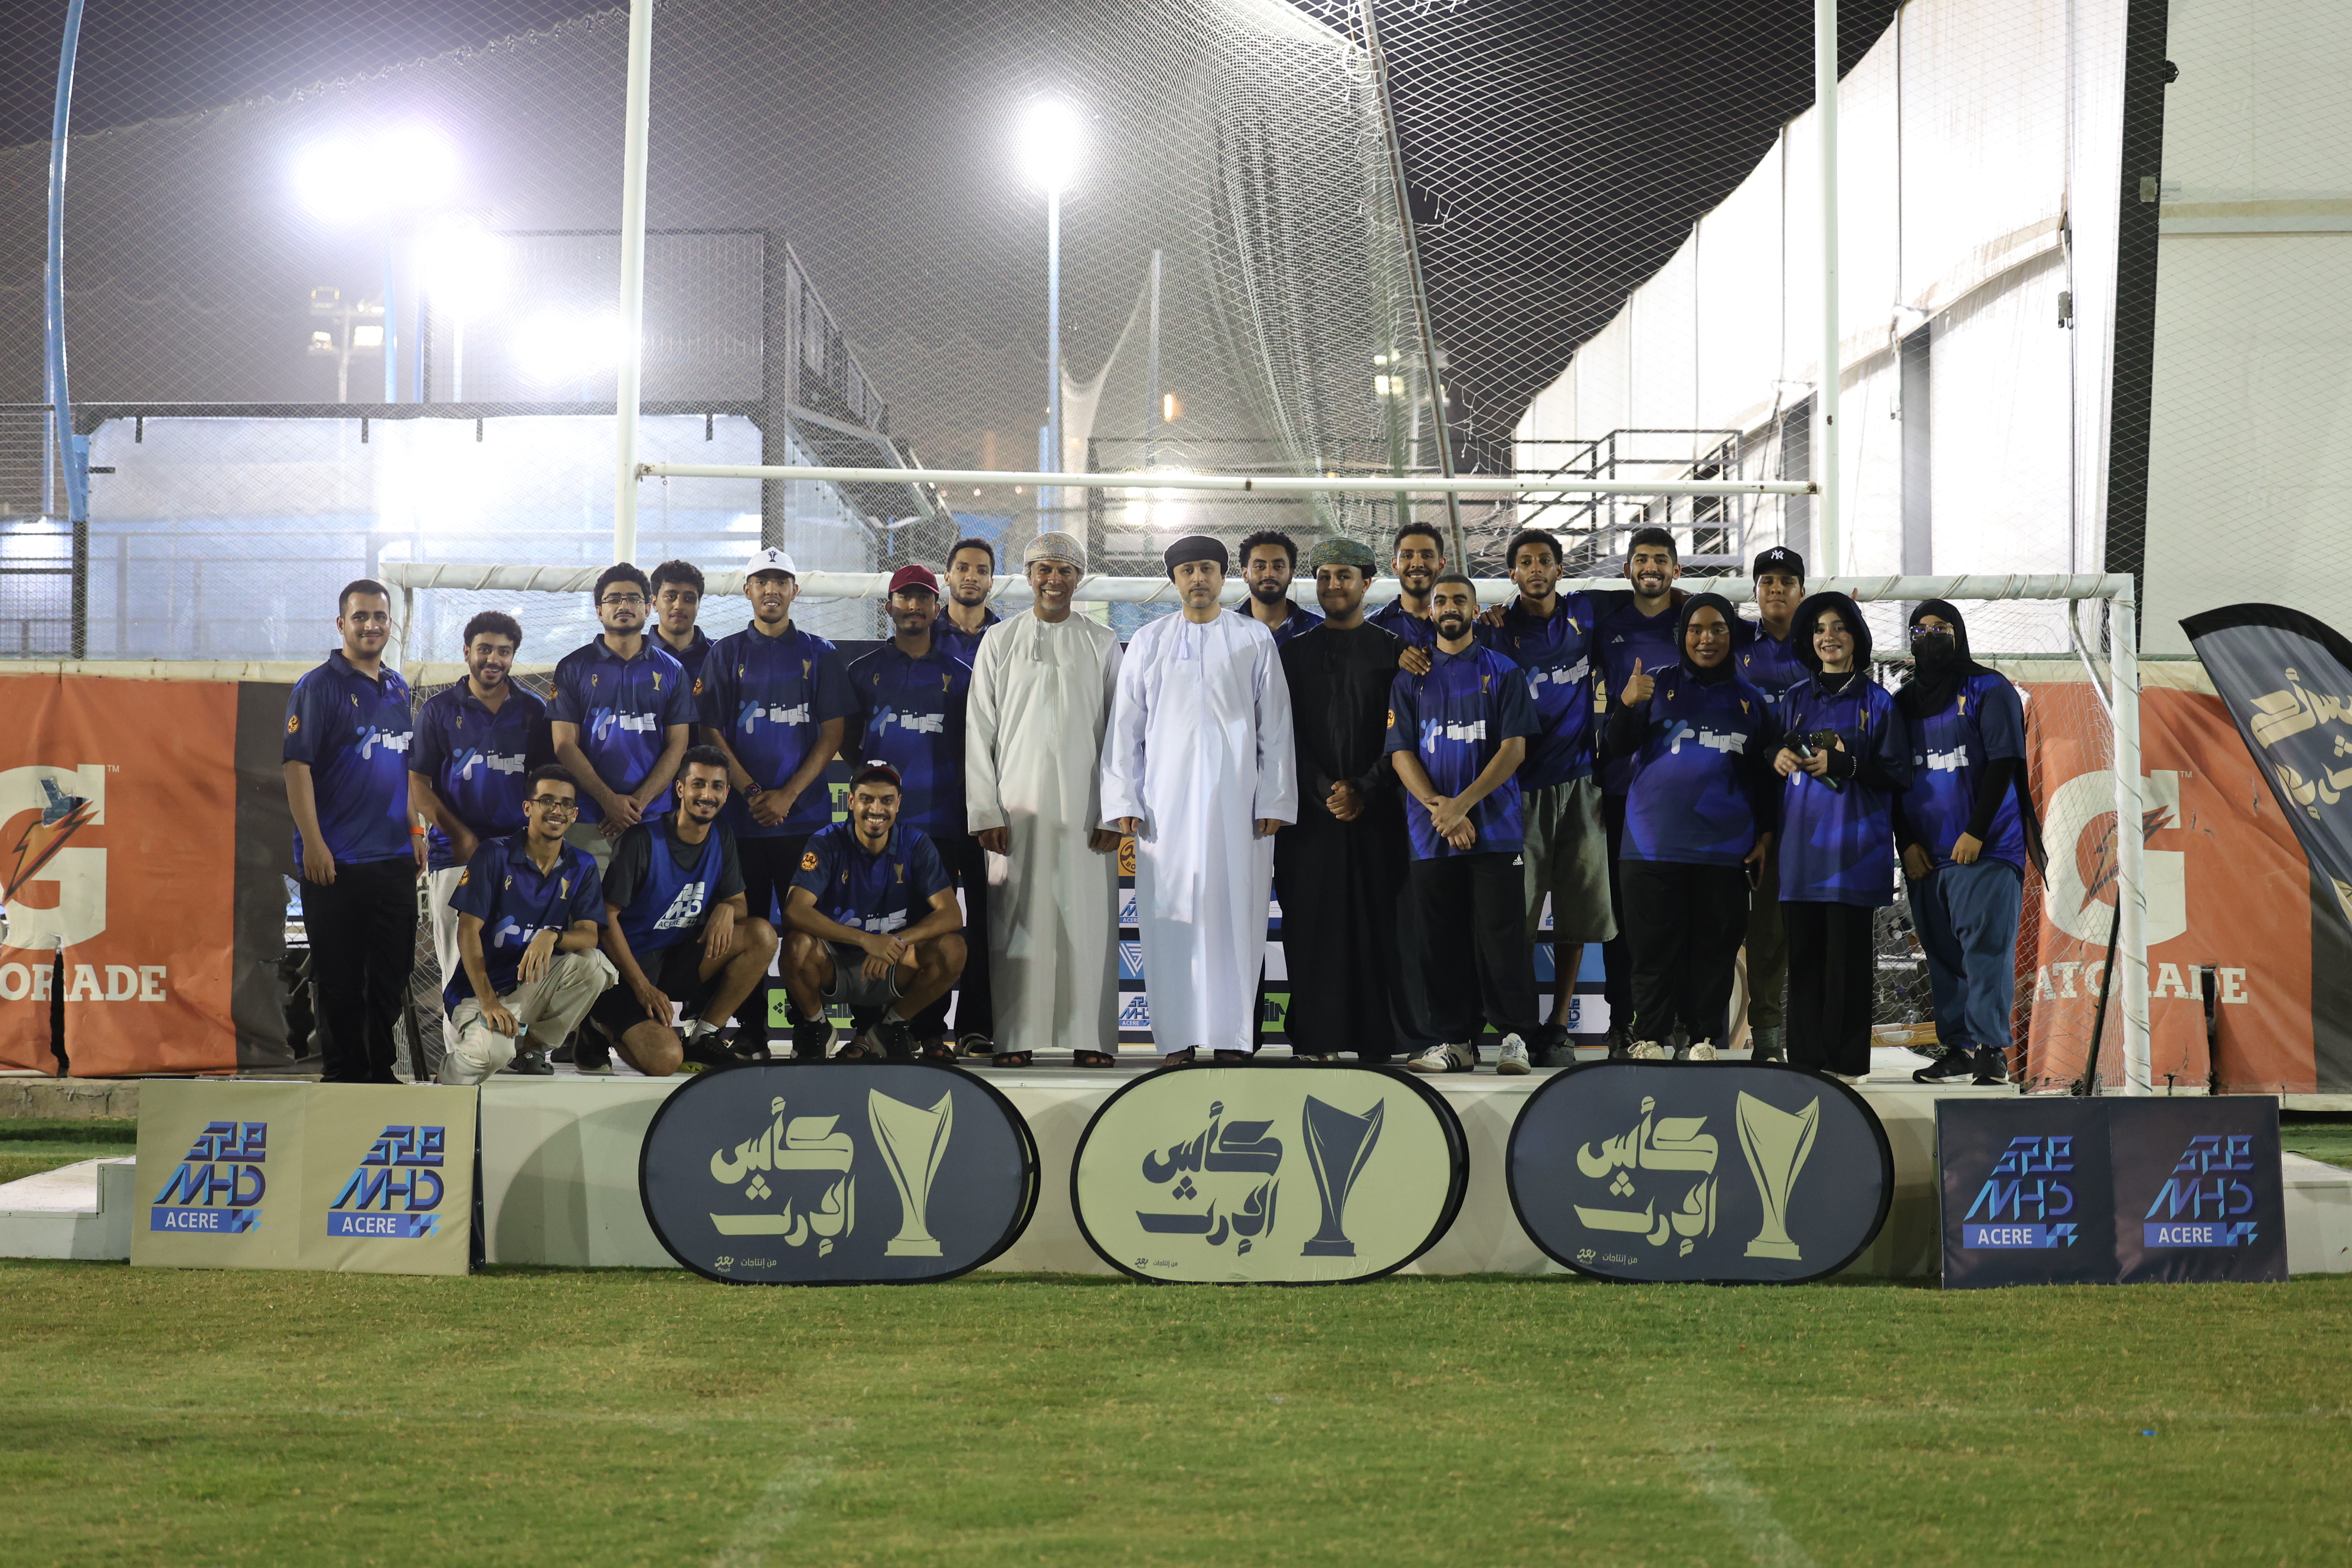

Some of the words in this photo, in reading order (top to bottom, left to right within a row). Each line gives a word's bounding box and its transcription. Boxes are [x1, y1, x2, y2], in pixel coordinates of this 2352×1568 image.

[0, 764, 107, 950] G
[107, 765, 120, 773] TM
[2043, 770, 2186, 947] G
[659, 900, 702, 920] MHD
[658, 919, 680, 928] ACERE
[710, 1096, 854, 1184] كأس
[1142, 1100, 1283, 1184] كأس
[1576, 1095, 1719, 1178] كأس
[153, 1163, 266, 1206] MHD
[330, 1167, 445, 1211] MHD
[1964, 1179, 2077, 1221] MHD
[2144, 1177, 2257, 1220] MHD
[165, 1212, 218, 1230] ACERE
[342, 1217, 396, 1234] ACERE
[1978, 1228, 2032, 1244] ACERE
[2158, 1227, 2213, 1243] ACERE
[741, 1257, 765, 1269] إنتاجات
[767, 1259, 777, 1268] من
[1602, 1253, 1626, 1265] إنتاجات
[1628, 1256, 1638, 1265] من
